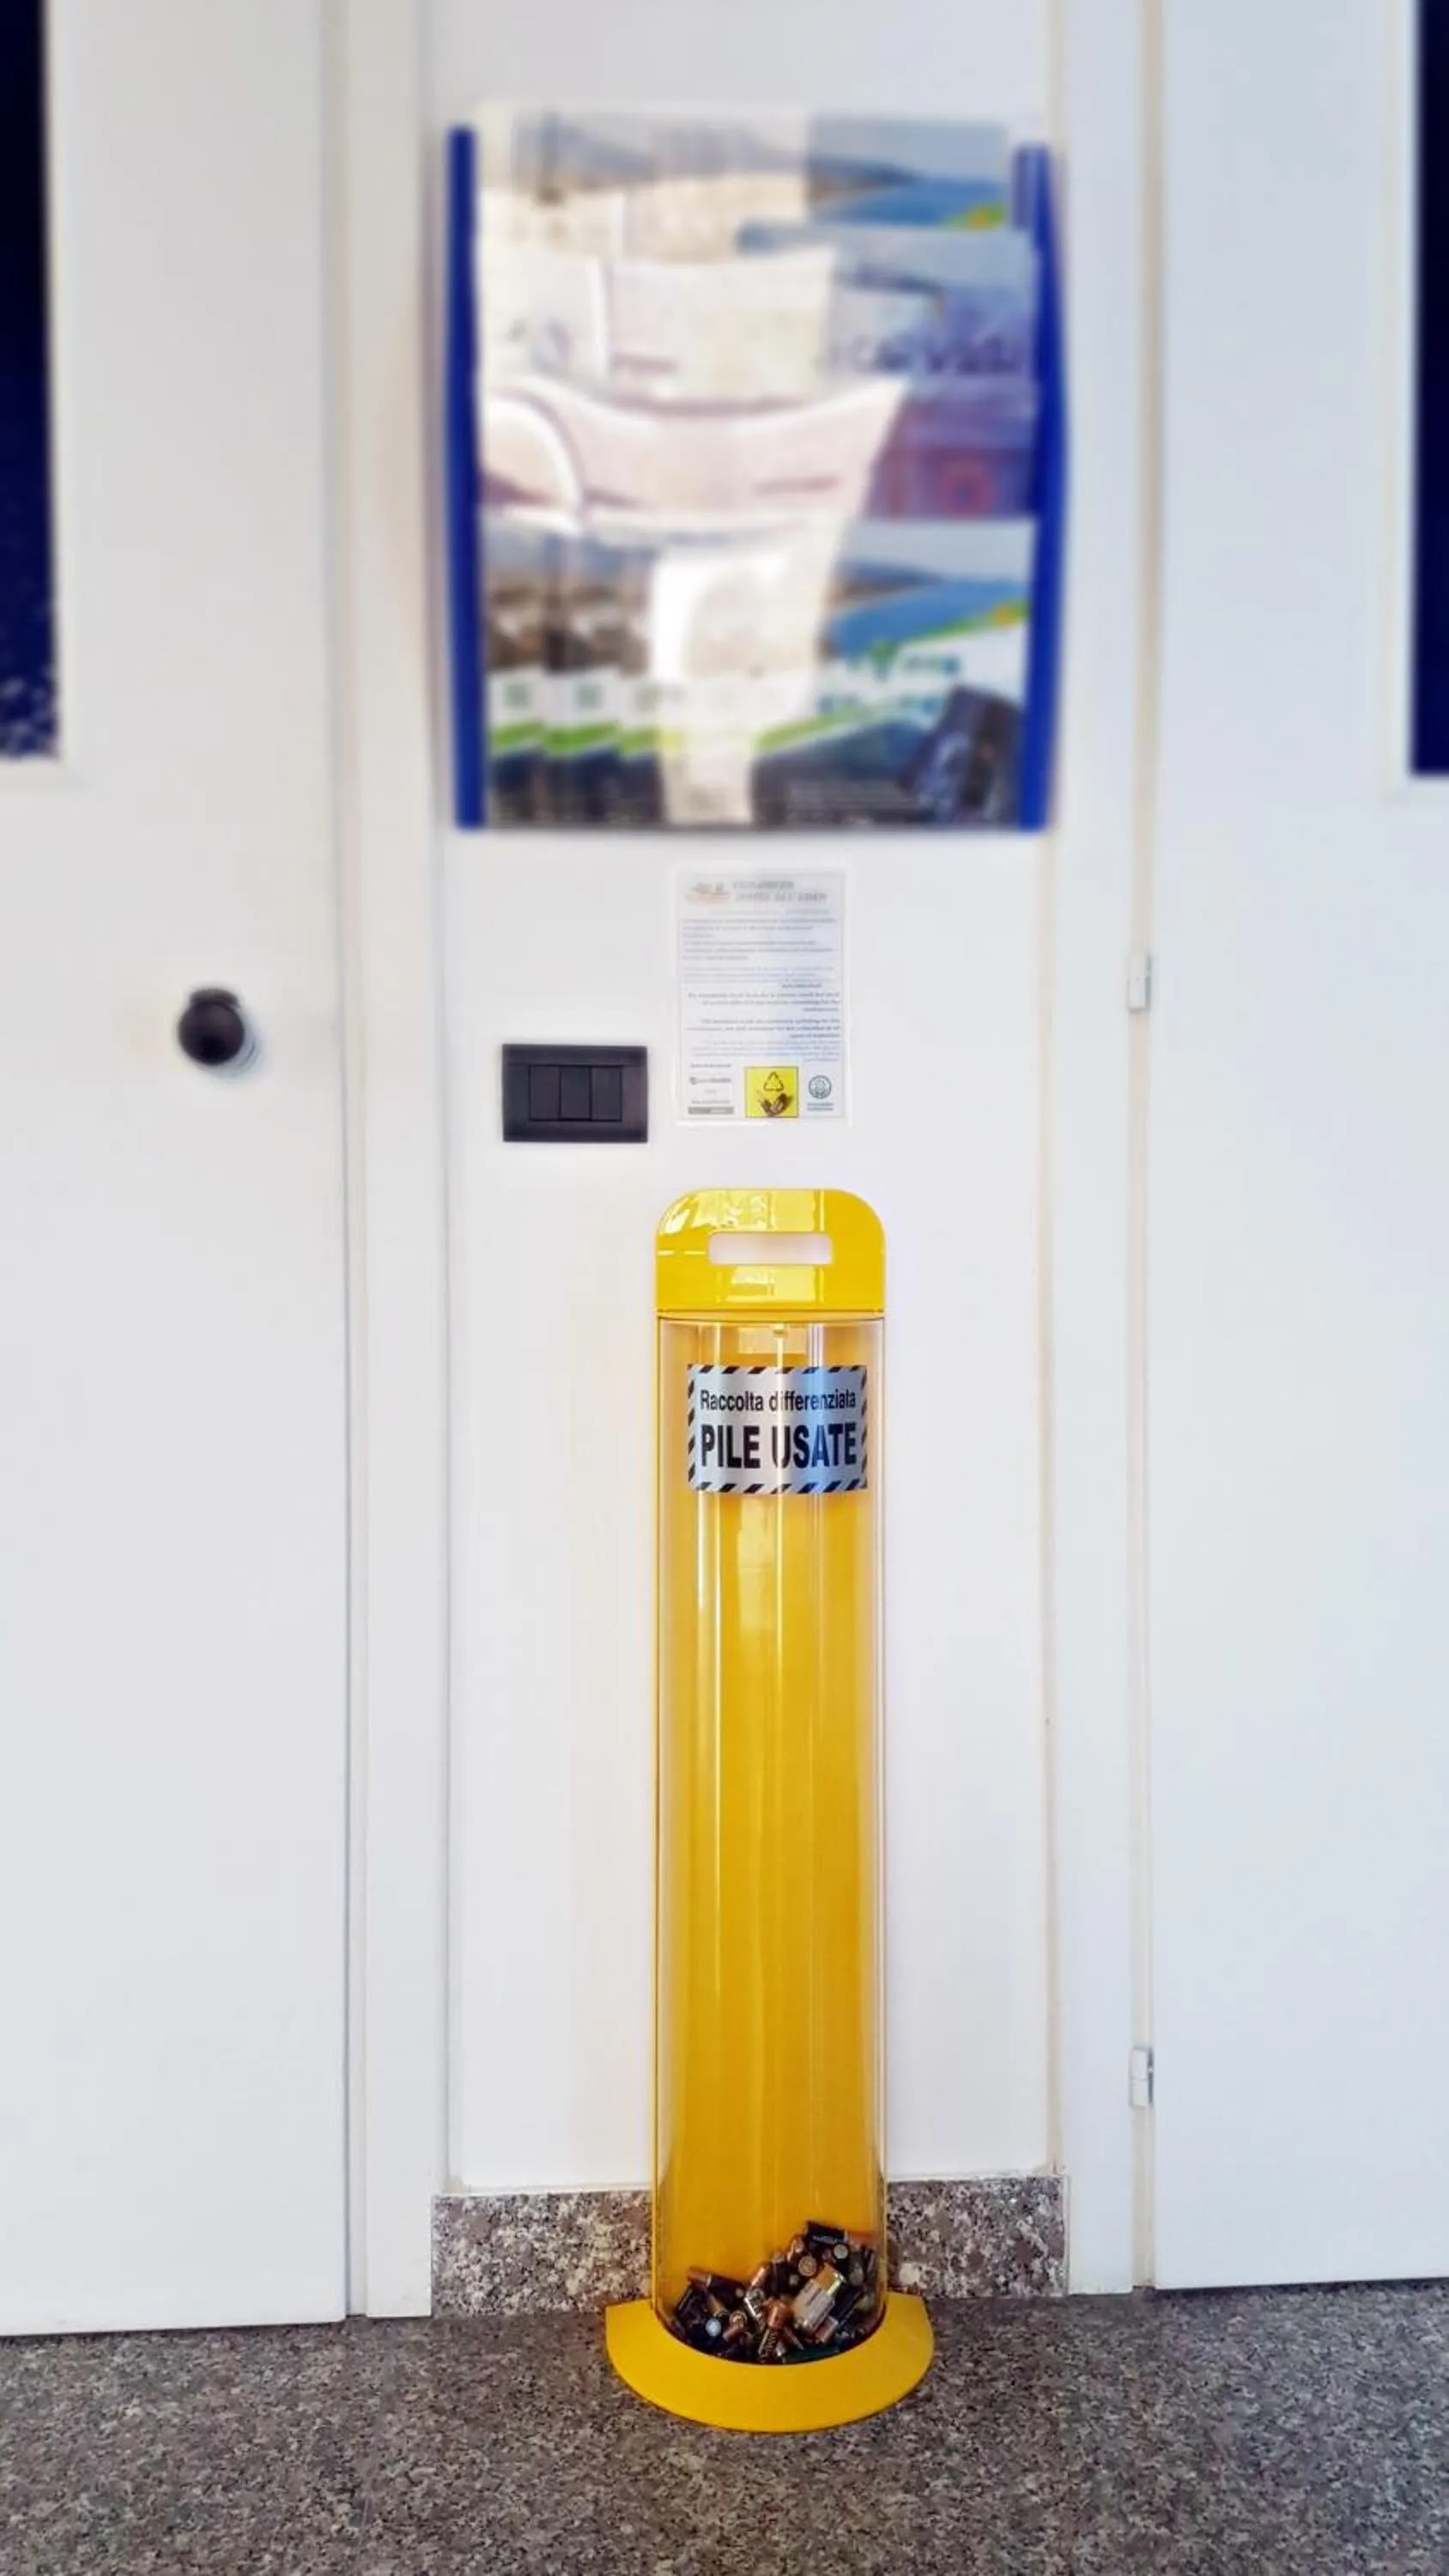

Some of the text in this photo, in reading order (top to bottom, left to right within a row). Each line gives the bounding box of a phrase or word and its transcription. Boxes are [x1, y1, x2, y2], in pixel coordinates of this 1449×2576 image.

[700, 1388, 856, 1411] Raccolta differenziata
[701, 1422, 857, 1469] PILE USATE
